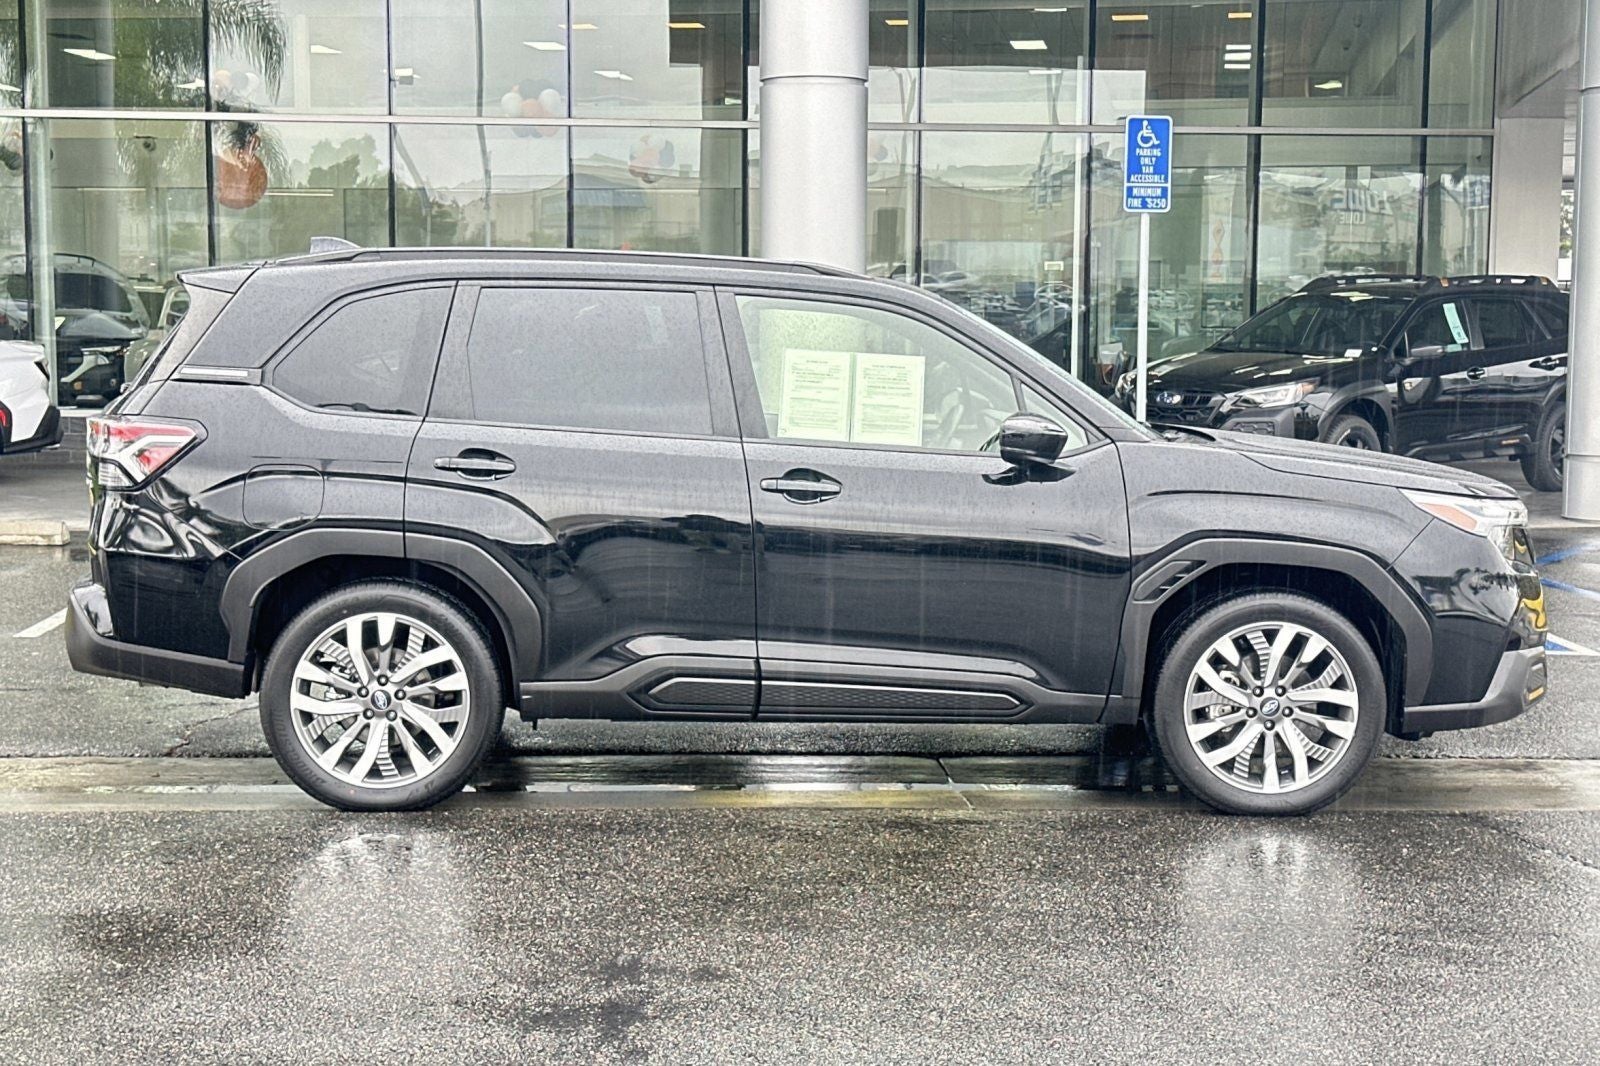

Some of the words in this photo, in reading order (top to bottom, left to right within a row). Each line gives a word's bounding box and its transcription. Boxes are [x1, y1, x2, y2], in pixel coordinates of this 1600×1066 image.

[1136, 148, 1162, 157] PARKING
[1140, 157, 1157, 165] ONLY
[1130, 174, 1165, 183] ACCESSIBLE
[1132, 187, 1162, 197] MINIMUM
[1127, 197, 1142, 208] FINE
[1144, 198, 1166, 208] $250
